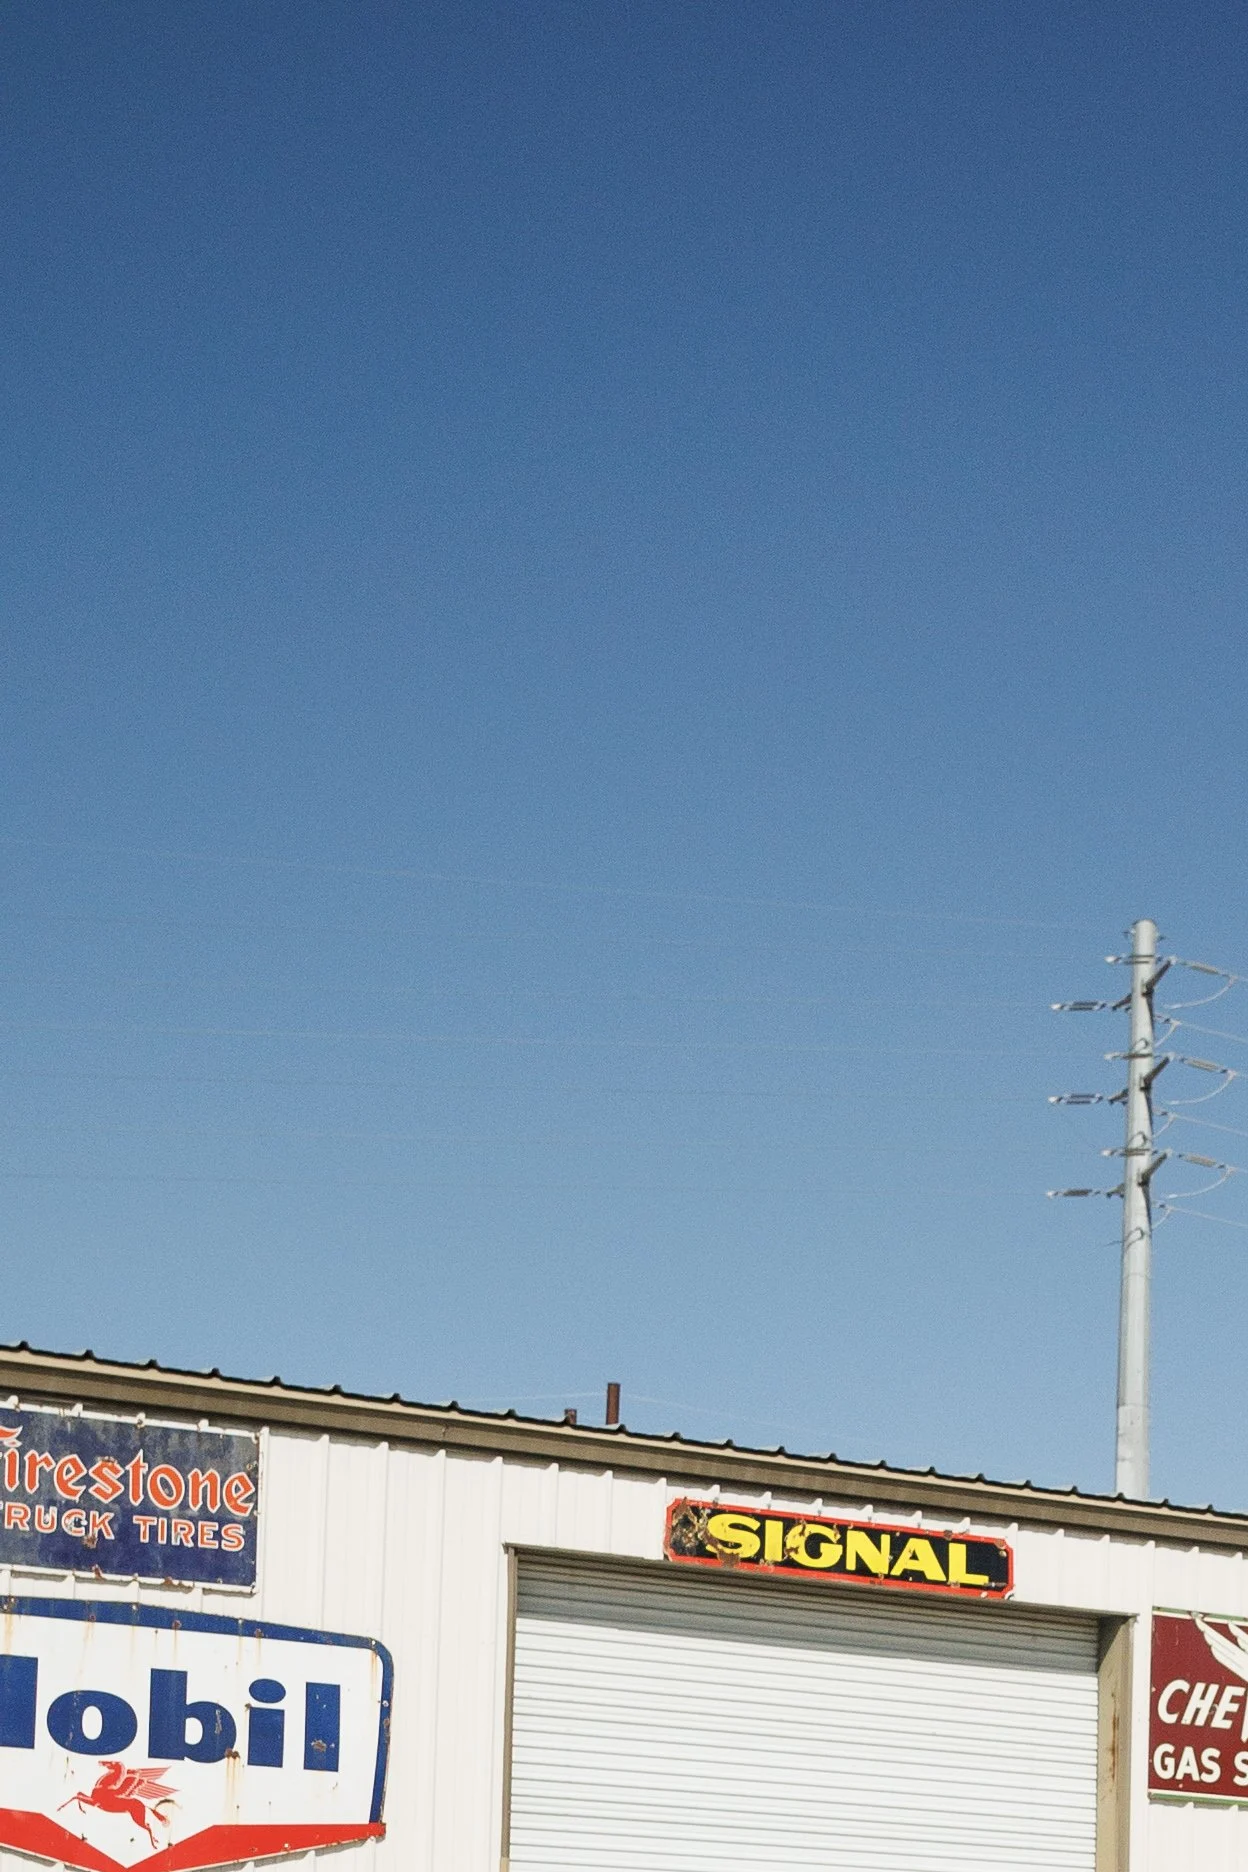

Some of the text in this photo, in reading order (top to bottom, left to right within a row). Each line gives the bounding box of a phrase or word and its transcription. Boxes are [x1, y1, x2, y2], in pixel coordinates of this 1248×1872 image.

[0, 1500, 246, 1552] RUCK TIRES
[705, 1513, 990, 1587] SIGNAL
[1153, 1743, 1221, 1784] GAS
